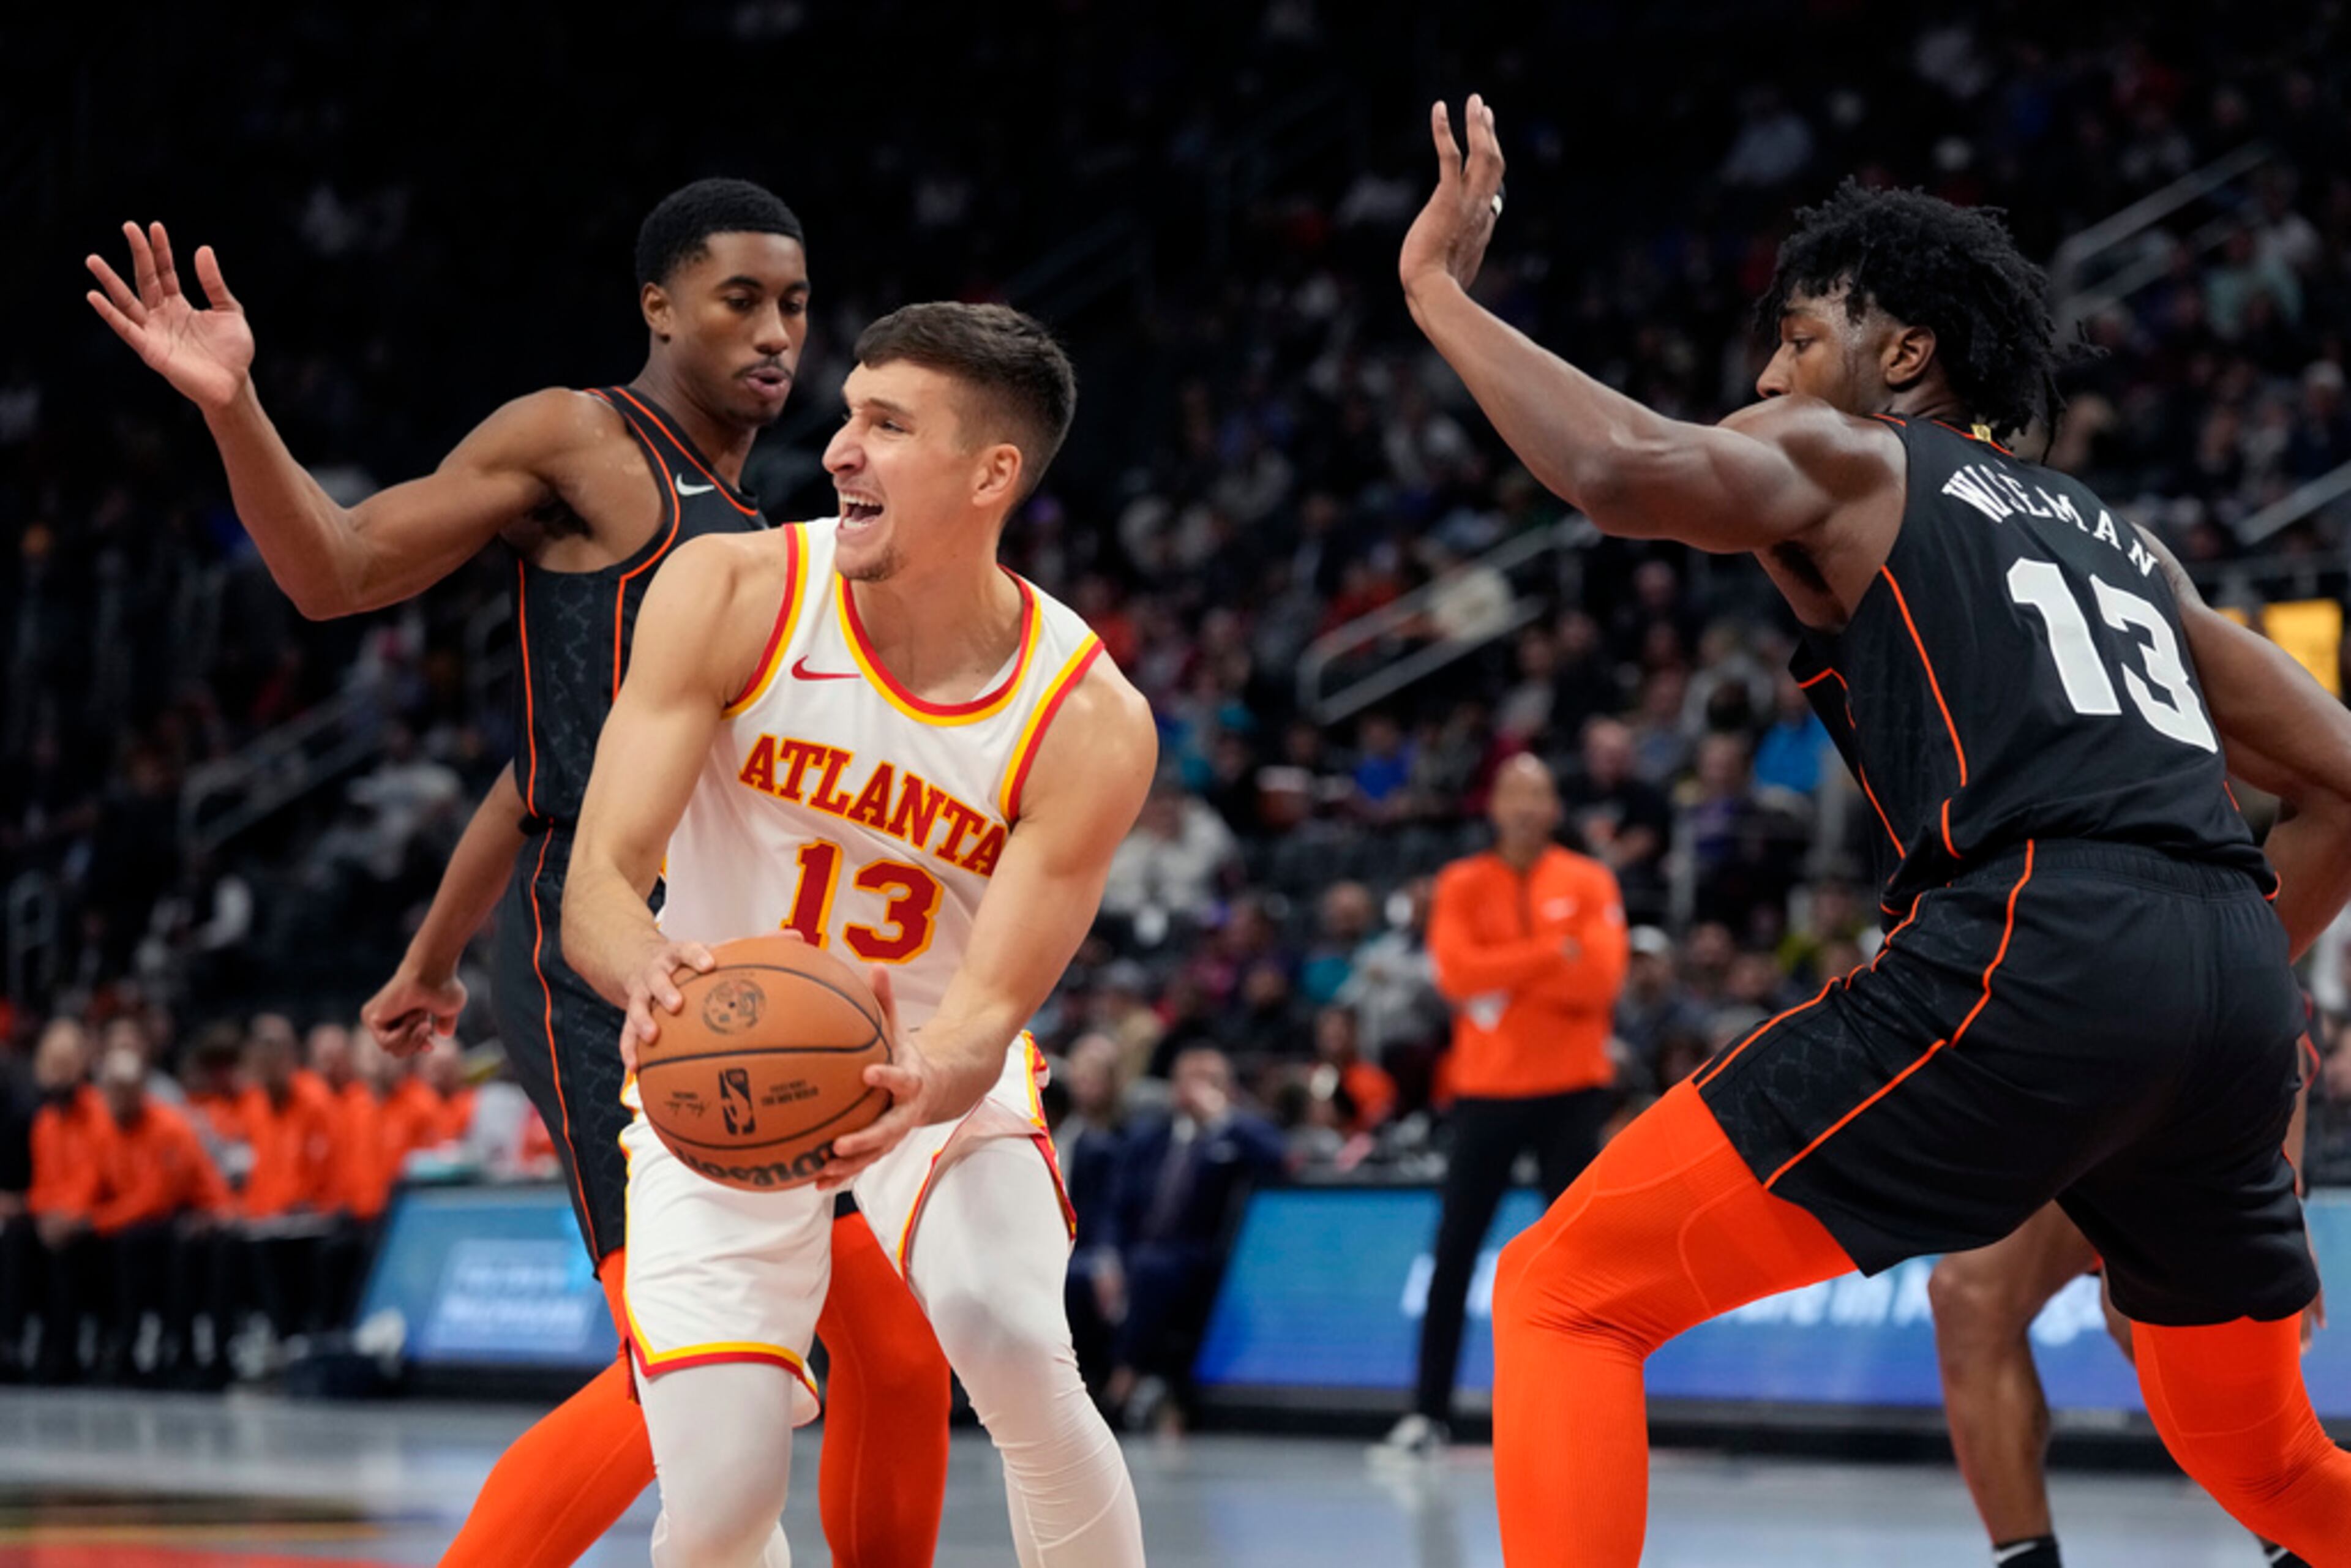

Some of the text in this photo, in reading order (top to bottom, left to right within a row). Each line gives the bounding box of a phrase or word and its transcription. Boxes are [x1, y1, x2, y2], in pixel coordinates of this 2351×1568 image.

[2006, 557, 2218, 754] 13
[738, 733, 1008, 878] ATLANTA
[781, 837, 943, 964] 13
